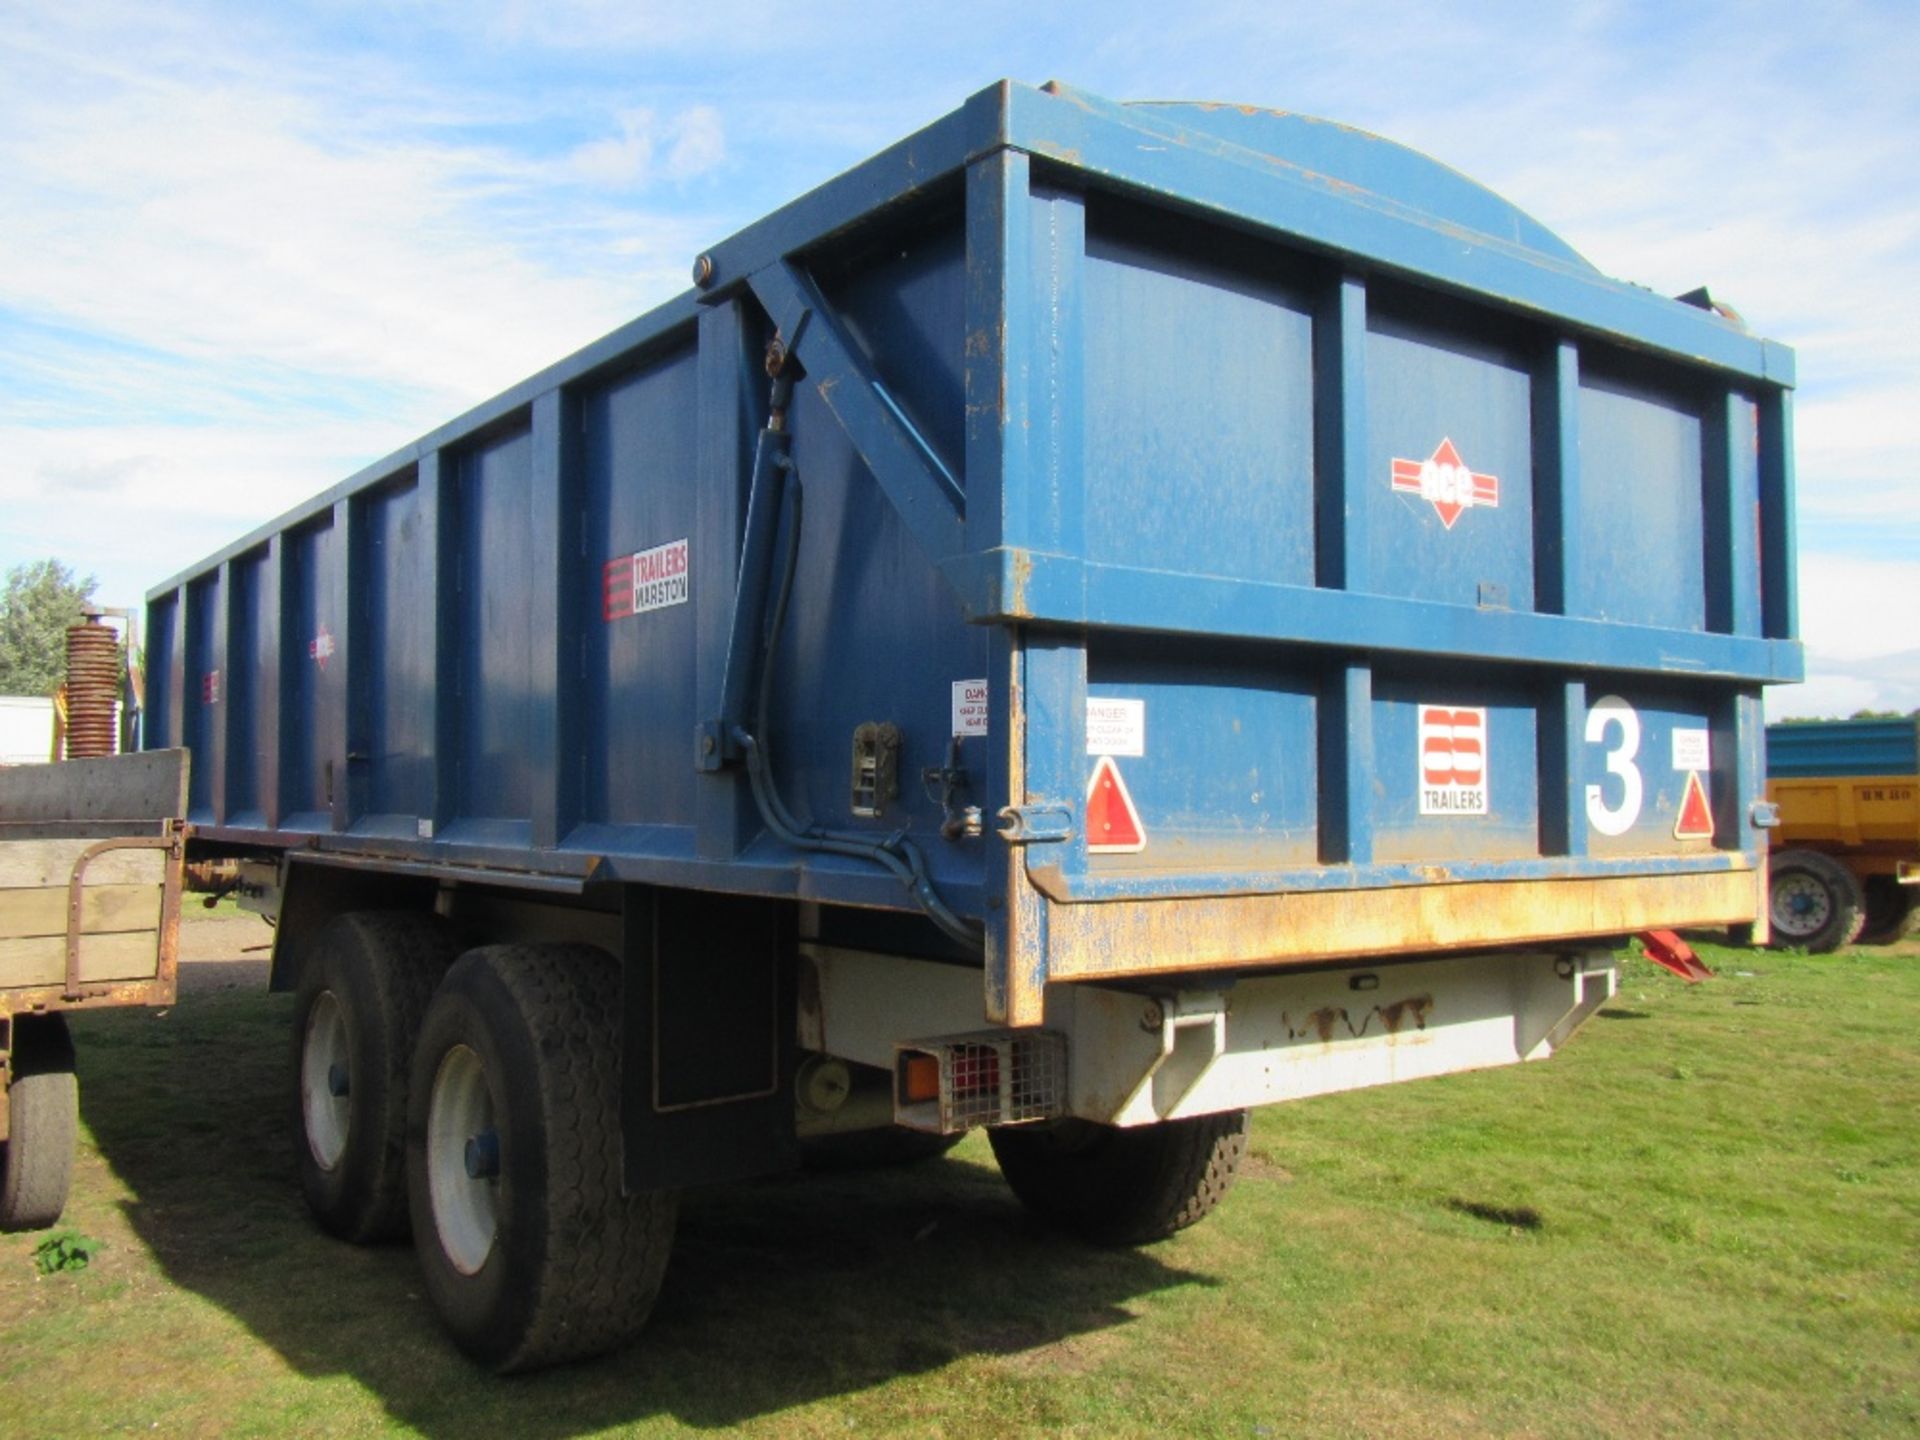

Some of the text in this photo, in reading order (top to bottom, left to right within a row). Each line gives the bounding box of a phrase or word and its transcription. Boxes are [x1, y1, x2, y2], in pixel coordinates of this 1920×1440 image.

[634, 544, 687, 585] TRAILERS
[1585, 694, 1643, 836] 3
[1424, 790, 1483, 811] TRAILERS
